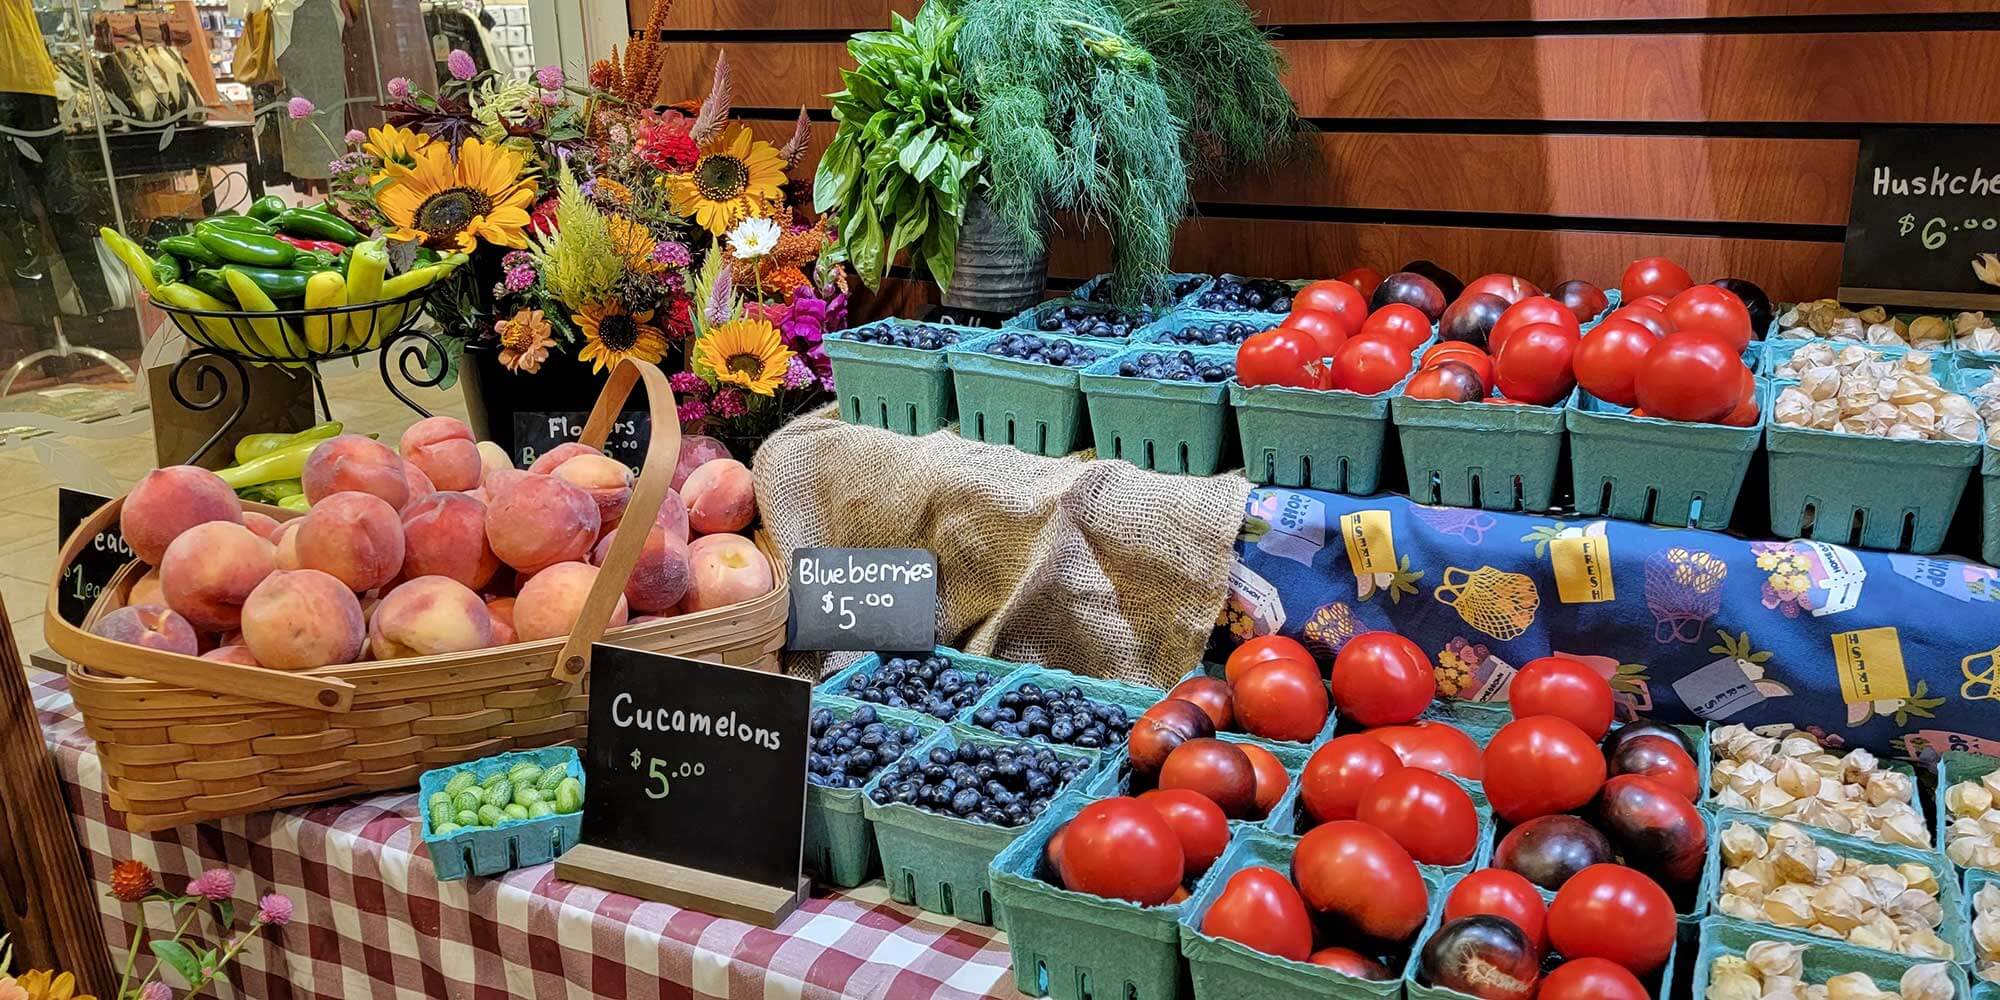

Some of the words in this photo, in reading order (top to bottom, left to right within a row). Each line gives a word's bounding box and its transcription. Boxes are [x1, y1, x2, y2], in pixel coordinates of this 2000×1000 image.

[1898, 213, 1998, 250] $6.00
[548, 416, 635, 439] Flors
[1280, 494, 1303, 529] SHOP
[1353, 513, 1372, 568] FRESH
[799, 554, 934, 586] Blueberries
[1583, 542, 1601, 601] FRESH
[821, 590, 895, 630] $5.00
[1848, 633, 1872, 696] FRESH
[1693, 683, 1749, 715] FRESH
[612, 692, 781, 751] Cucamelons
[629, 747, 706, 800] $5.00
